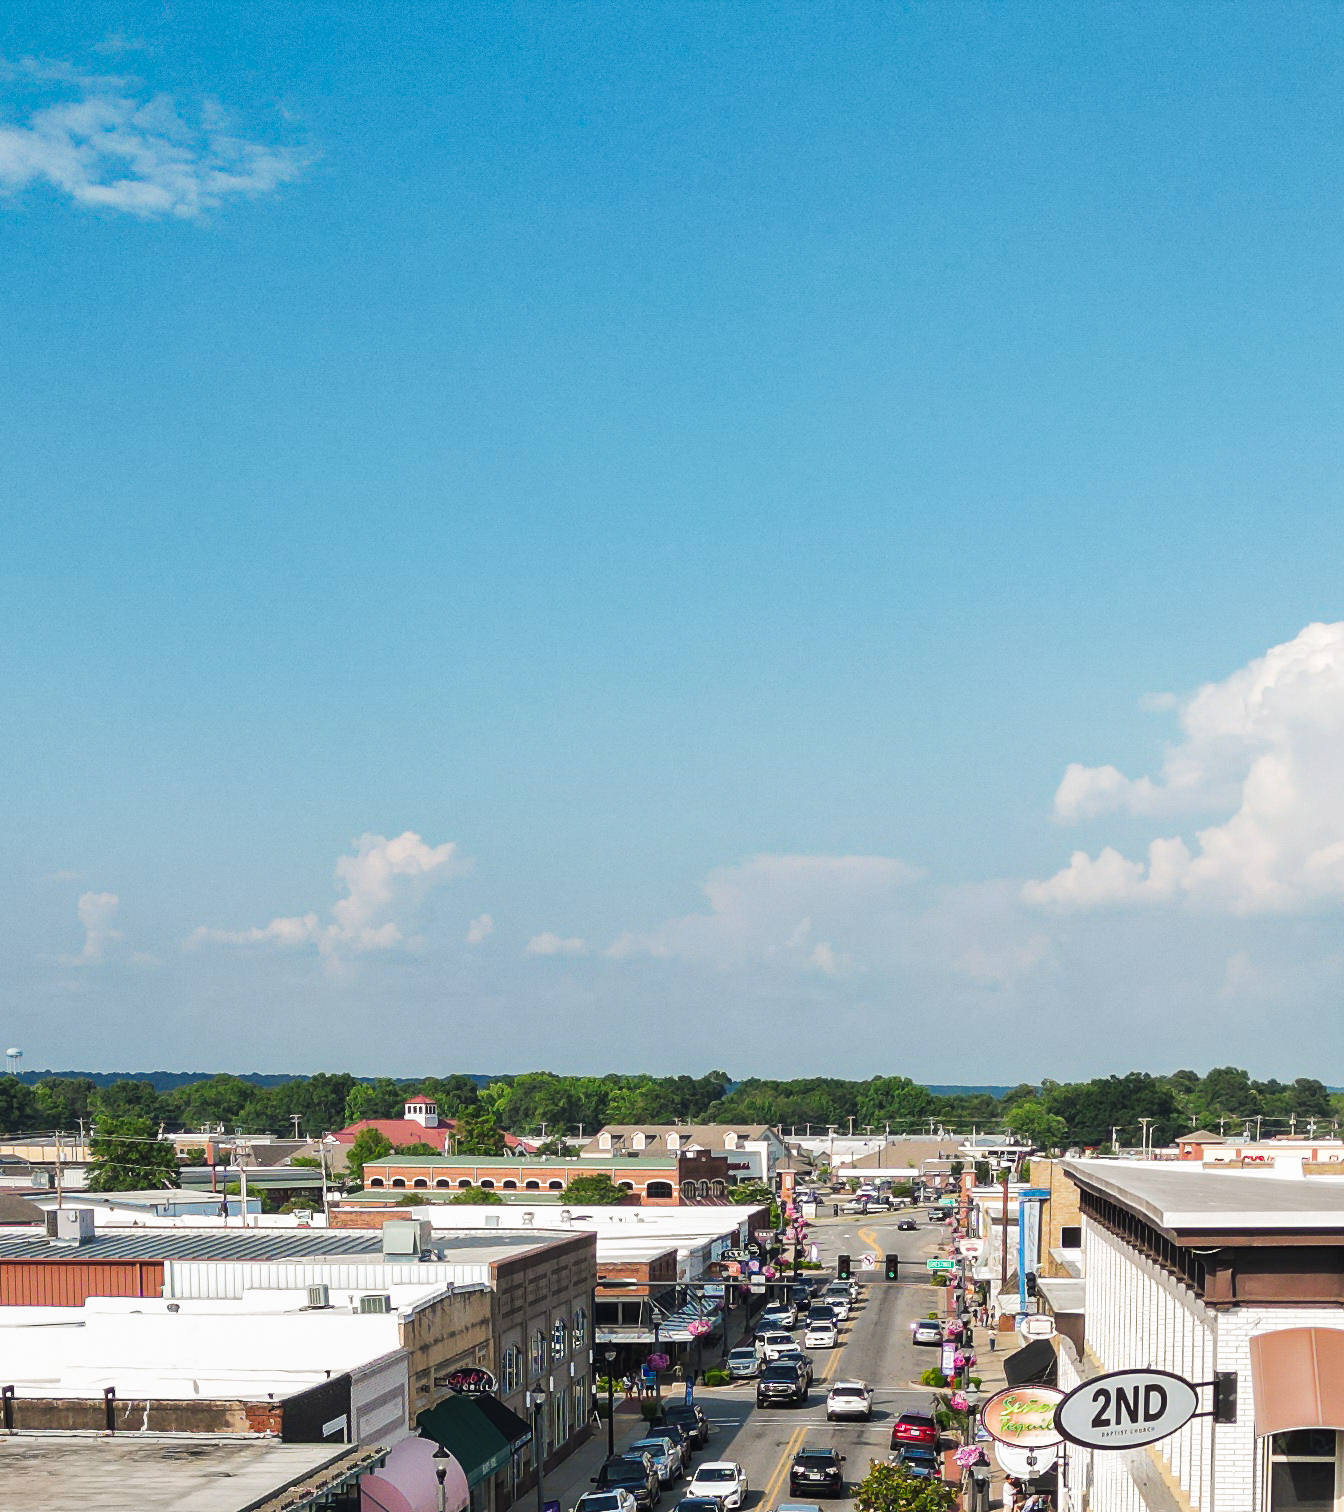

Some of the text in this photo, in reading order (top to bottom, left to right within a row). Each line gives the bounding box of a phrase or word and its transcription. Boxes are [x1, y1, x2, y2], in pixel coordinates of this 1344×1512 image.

[1091, 1383, 1168, 1429] 2ND
[999, 1415, 1055, 1438] Tequil
[1101, 1426, 1155, 1438] BAPTIST CHURCH
